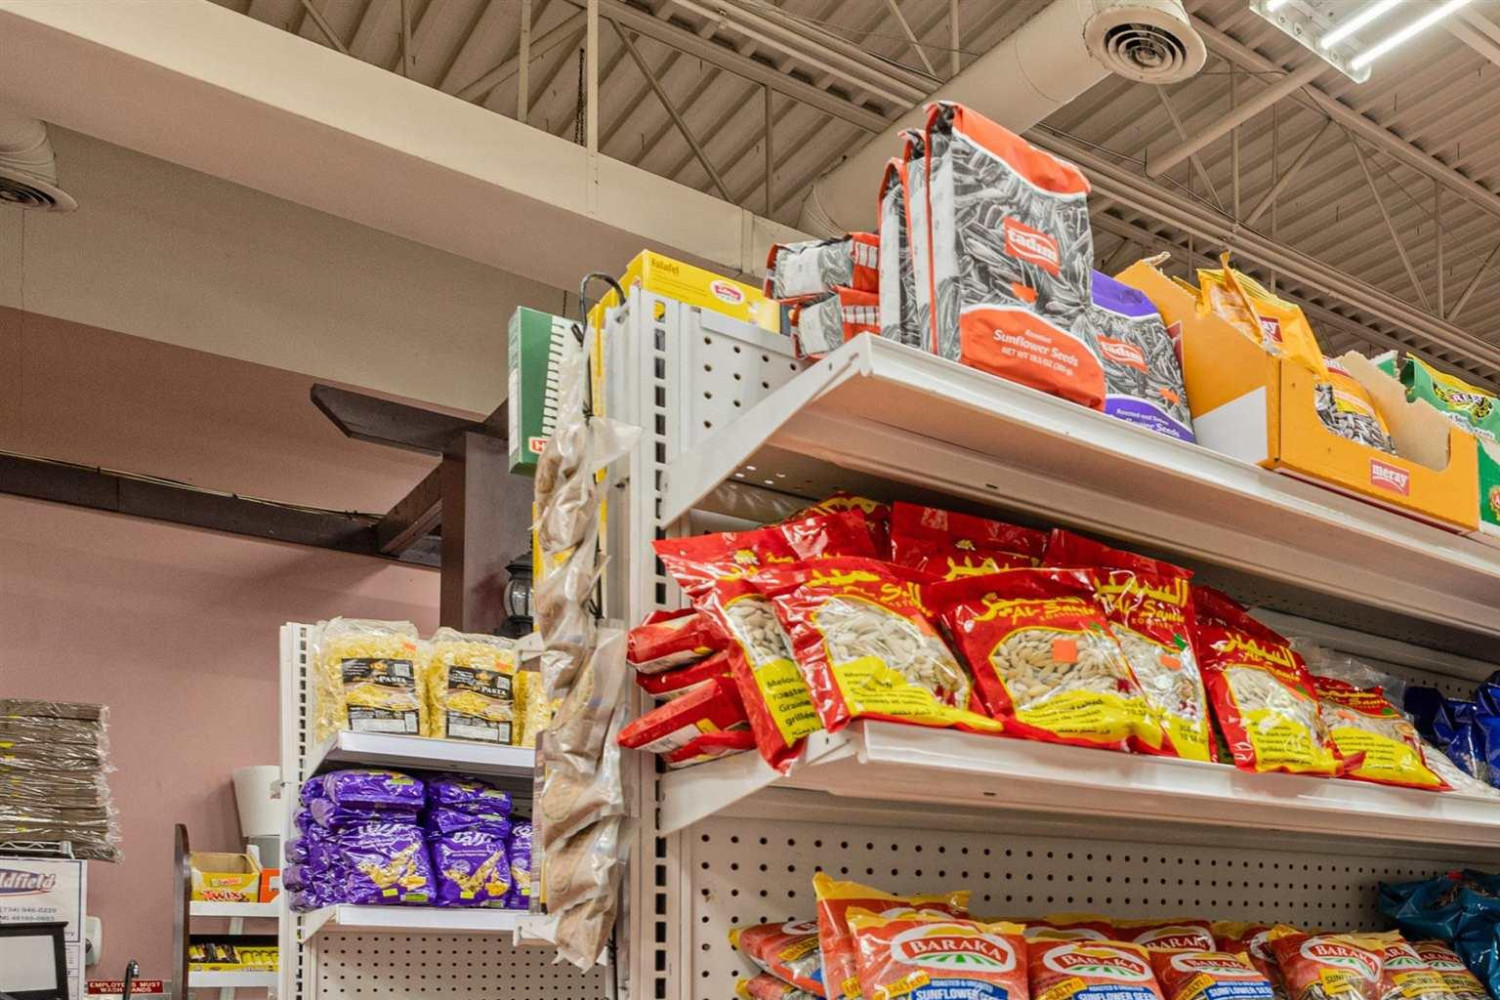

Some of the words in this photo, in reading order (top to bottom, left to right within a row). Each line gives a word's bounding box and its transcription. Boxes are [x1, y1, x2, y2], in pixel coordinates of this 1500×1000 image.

[993, 329, 1049, 354] Sunflower
[1050, 346, 1079, 367] Seeds
[1371, 462, 1408, 487] meray
[379, 676, 407, 684] PASTA
[481, 686, 508, 696] PASTA
[909, 939, 1002, 961] BARAKA
[1315, 944, 1377, 971] BARAKA
[1061, 954, 1142, 973] BARAKA
